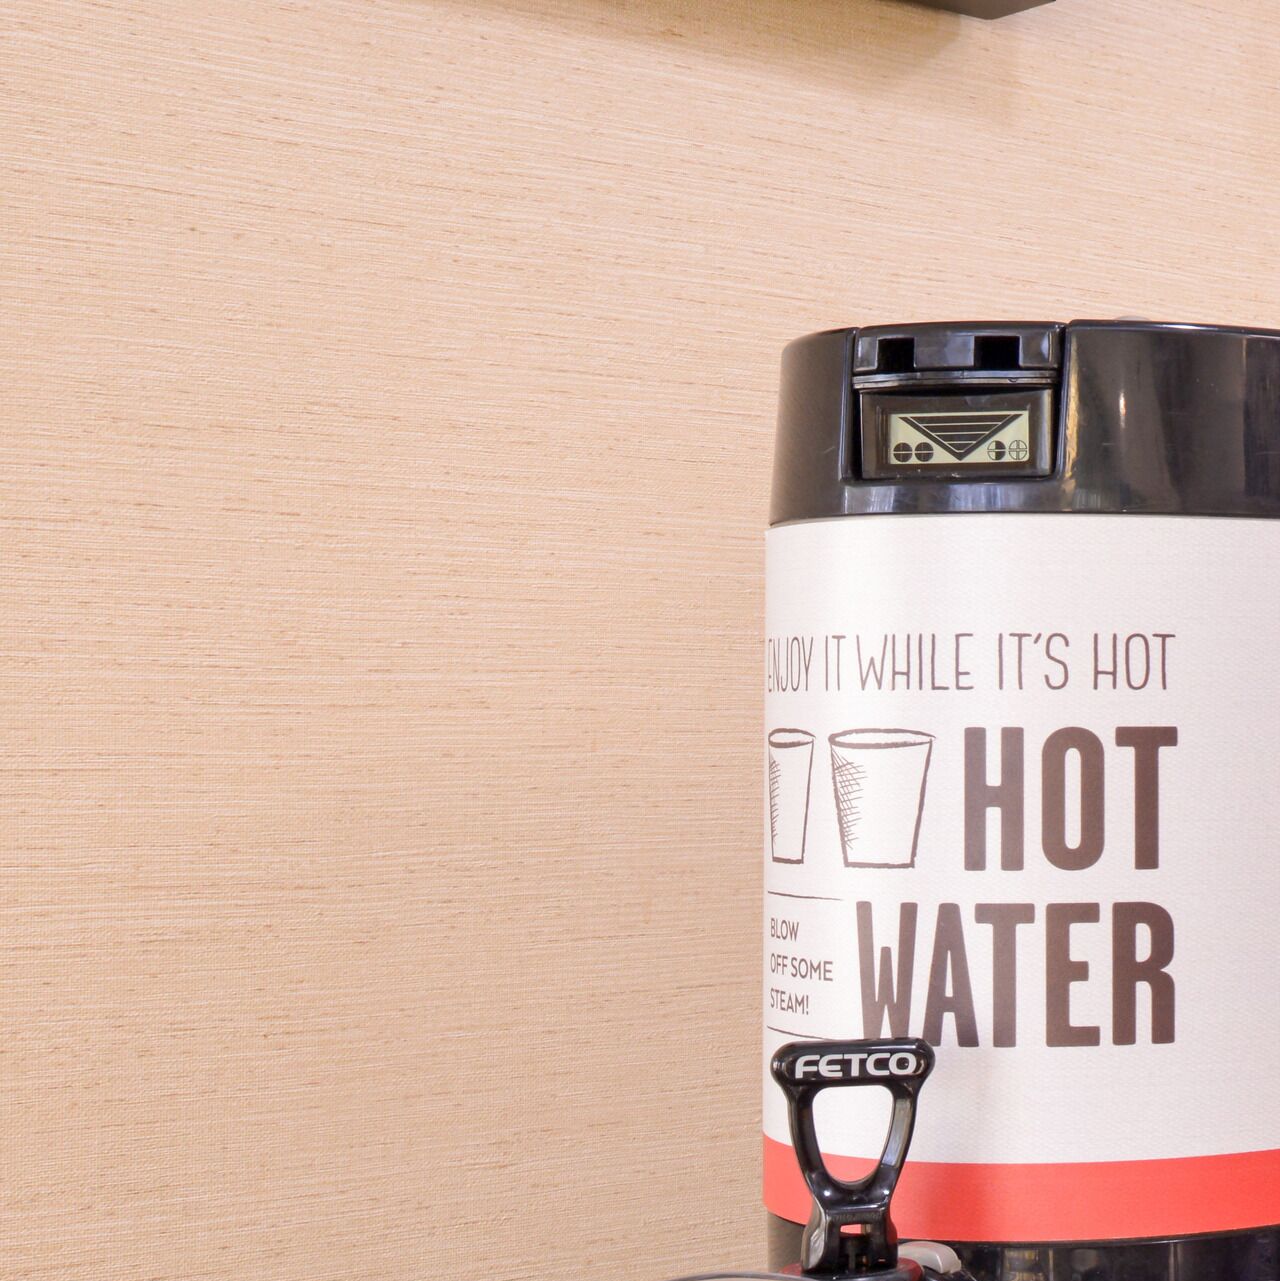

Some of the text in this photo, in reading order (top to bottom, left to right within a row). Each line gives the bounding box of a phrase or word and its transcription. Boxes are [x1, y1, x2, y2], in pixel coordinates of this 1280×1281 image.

[768, 632, 1176, 692] ENJOY IT WHILE IT'S HOT
[964, 726, 1178, 871] HOT
[771, 918, 799, 942] BLOW
[771, 953, 833, 981] OFF SOME
[856, 901, 1175, 1047] WATER
[771, 987, 809, 1015] STEAM!
[795, 1052, 917, 1079] FETCO
